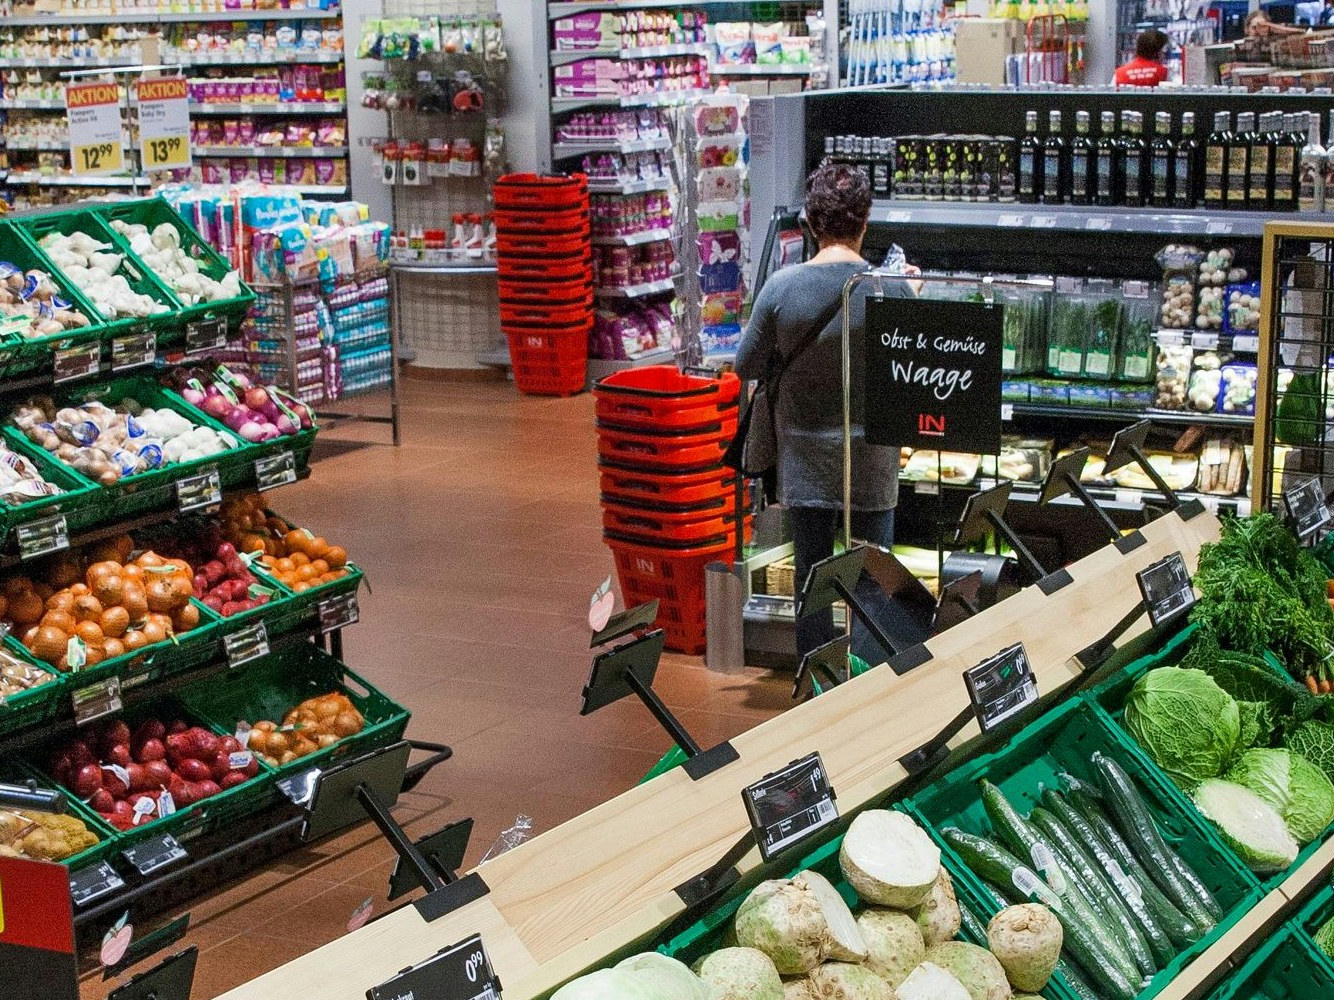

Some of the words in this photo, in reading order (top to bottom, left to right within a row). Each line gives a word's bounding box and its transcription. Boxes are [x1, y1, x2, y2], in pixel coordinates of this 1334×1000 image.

[68, 87, 117, 104] AKTION
[139, 83, 186, 98] AKTION
[881, 328, 912, 349] Obst
[916, 333, 927, 349] &
[933, 336, 986, 355] Gemüse
[891, 360, 973, 400] Waage
